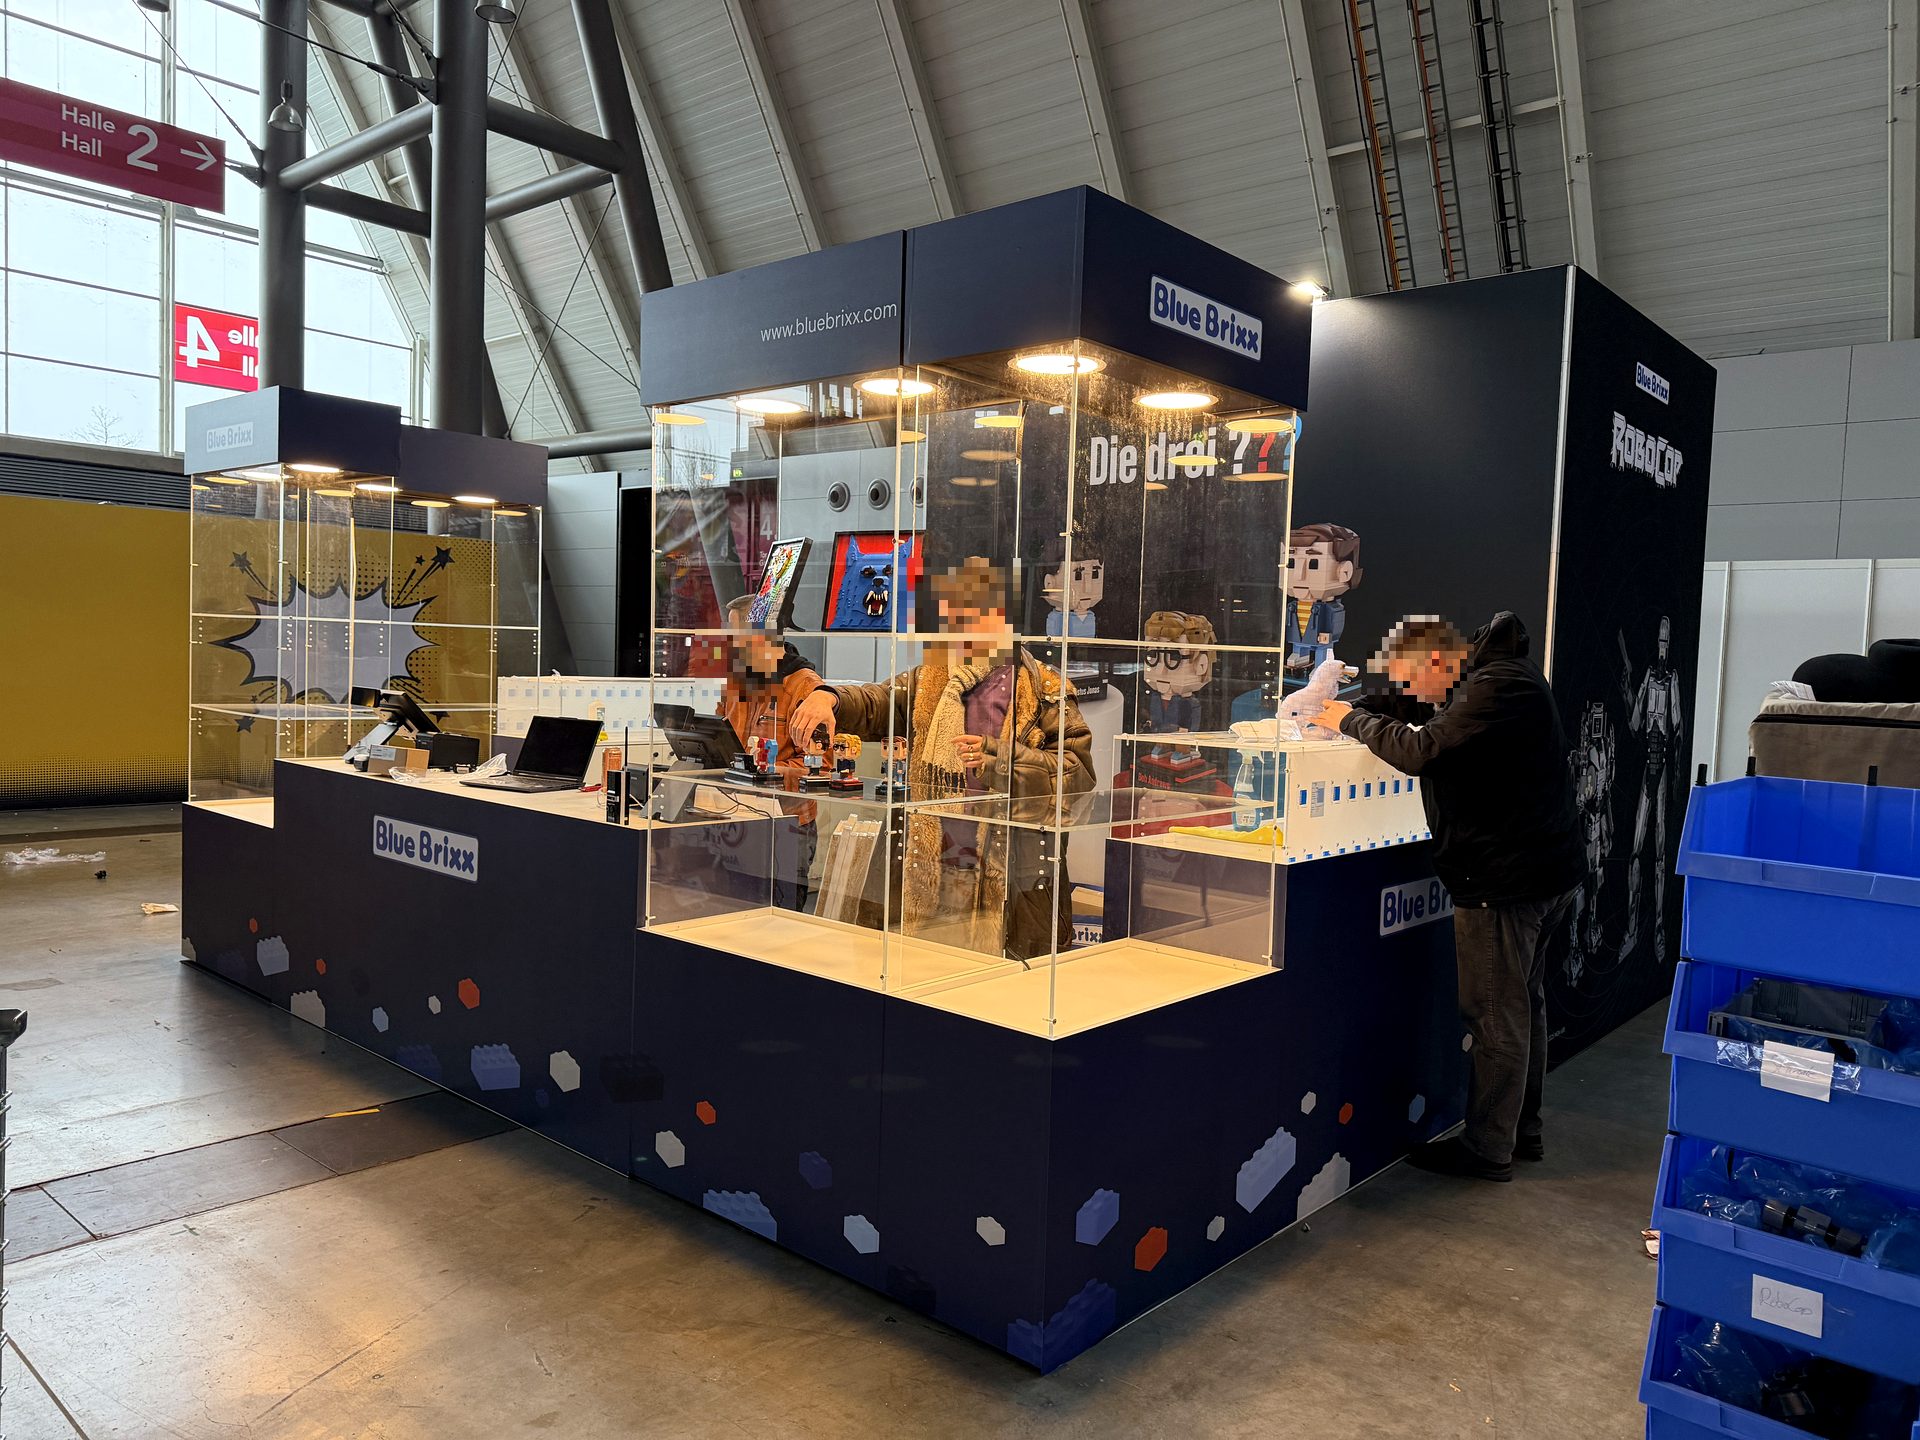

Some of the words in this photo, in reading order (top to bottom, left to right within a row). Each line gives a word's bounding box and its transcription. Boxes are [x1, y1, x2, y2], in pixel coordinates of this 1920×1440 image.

[61, 103, 116, 133] Halle
[61, 131, 102, 158] Hall
[126, 123, 158, 172] 2
[760, 302, 898, 342] www.bluebrixx.com
[1153, 281, 1202, 331] Blue
[1205, 303, 1259, 354] Brixx
[1636, 364, 1651, 391] Blue
[1651, 374, 1669, 401] Brixx
[207, 430, 227, 449] Blue
[227, 426, 252, 446] Brixx
[1089, 434, 1138, 486] Die
[1146, 426, 1217, 482] drei
[375, 819, 416, 859] Blue
[419, 830, 475, 874] Brixx
[1383, 889, 1425, 928] Blue
